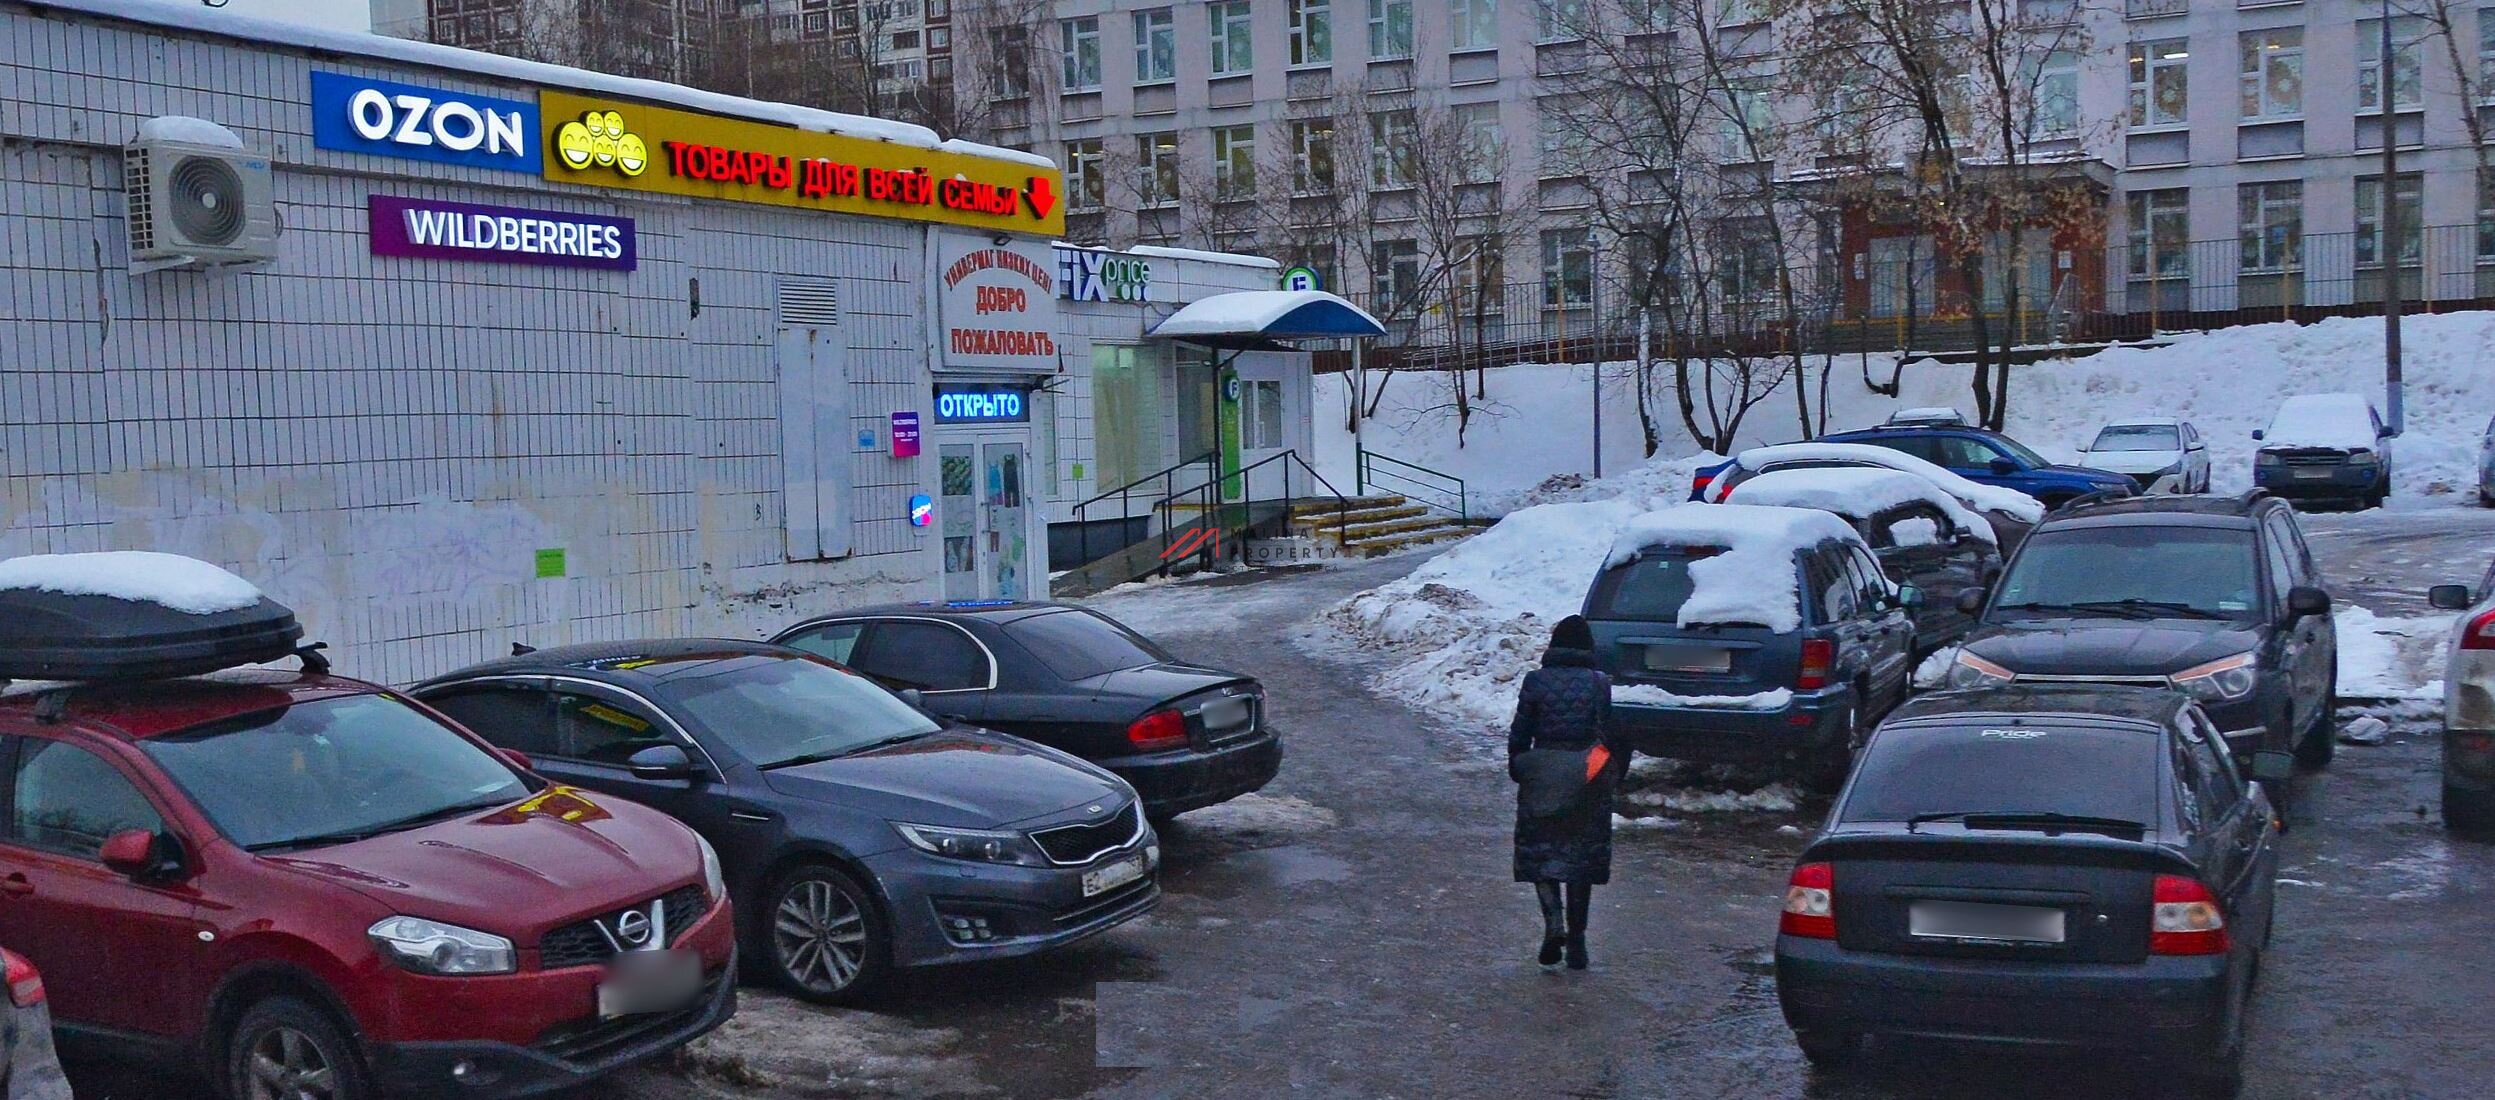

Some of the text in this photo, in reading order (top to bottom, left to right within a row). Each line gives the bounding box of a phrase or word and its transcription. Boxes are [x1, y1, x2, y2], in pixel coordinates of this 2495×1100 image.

[350, 88, 524, 157] OZON
[667, 140, 1019, 216] ТОВАРЫ ДЛЯ ВСЕЙ СЕМЬИ
[403, 208, 622, 259] WILDBERRIES
[943, 248, 995, 292] УНИВЕРМАГ
[1105, 257, 1151, 288] price
[975, 285, 1028, 316] ДОБРО
[951, 328, 1054, 356] ПОЖАЛОВАТЬ
[939, 393, 1020, 418] ОТКРЫТО
[1981, 728, 2048, 739] Pride
